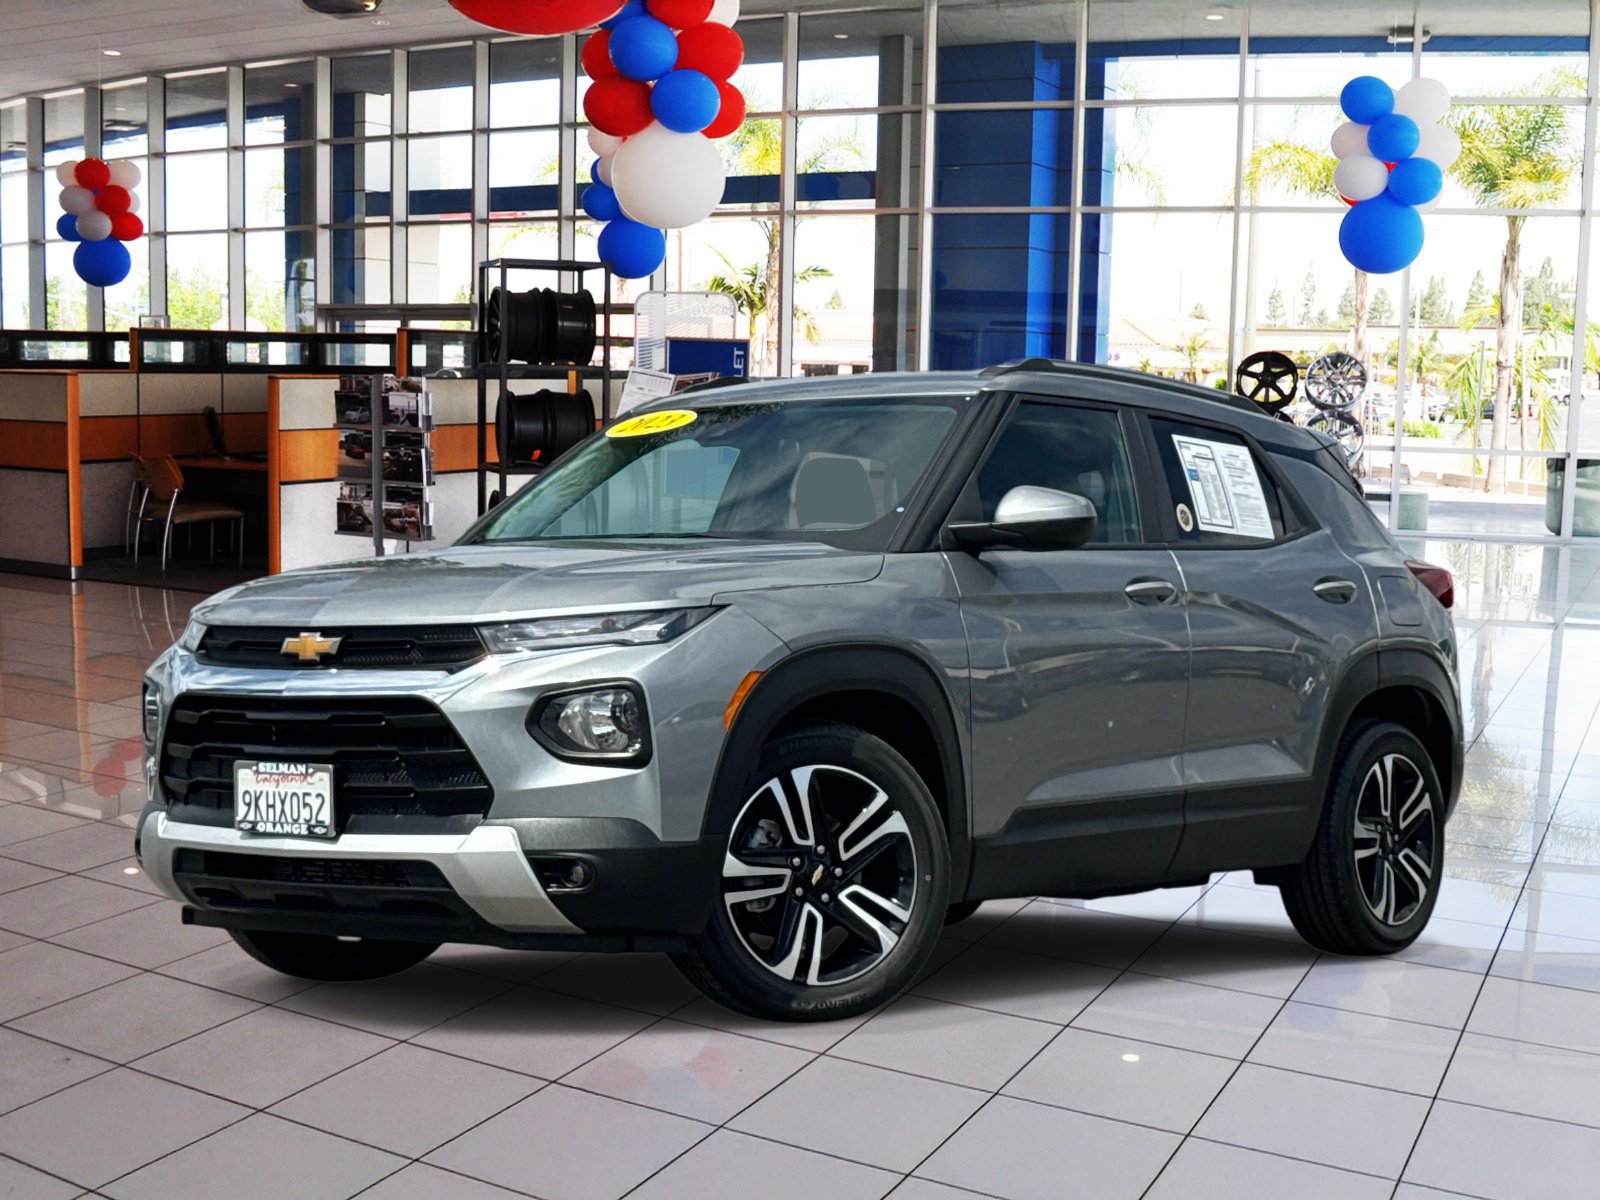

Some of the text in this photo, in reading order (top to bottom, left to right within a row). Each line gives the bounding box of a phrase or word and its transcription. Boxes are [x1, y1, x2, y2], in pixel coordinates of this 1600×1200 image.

[258, 762, 307, 774] SELMAN
[242, 789, 325, 824] 9KHX052
[256, 822, 309, 835] ORANGE
